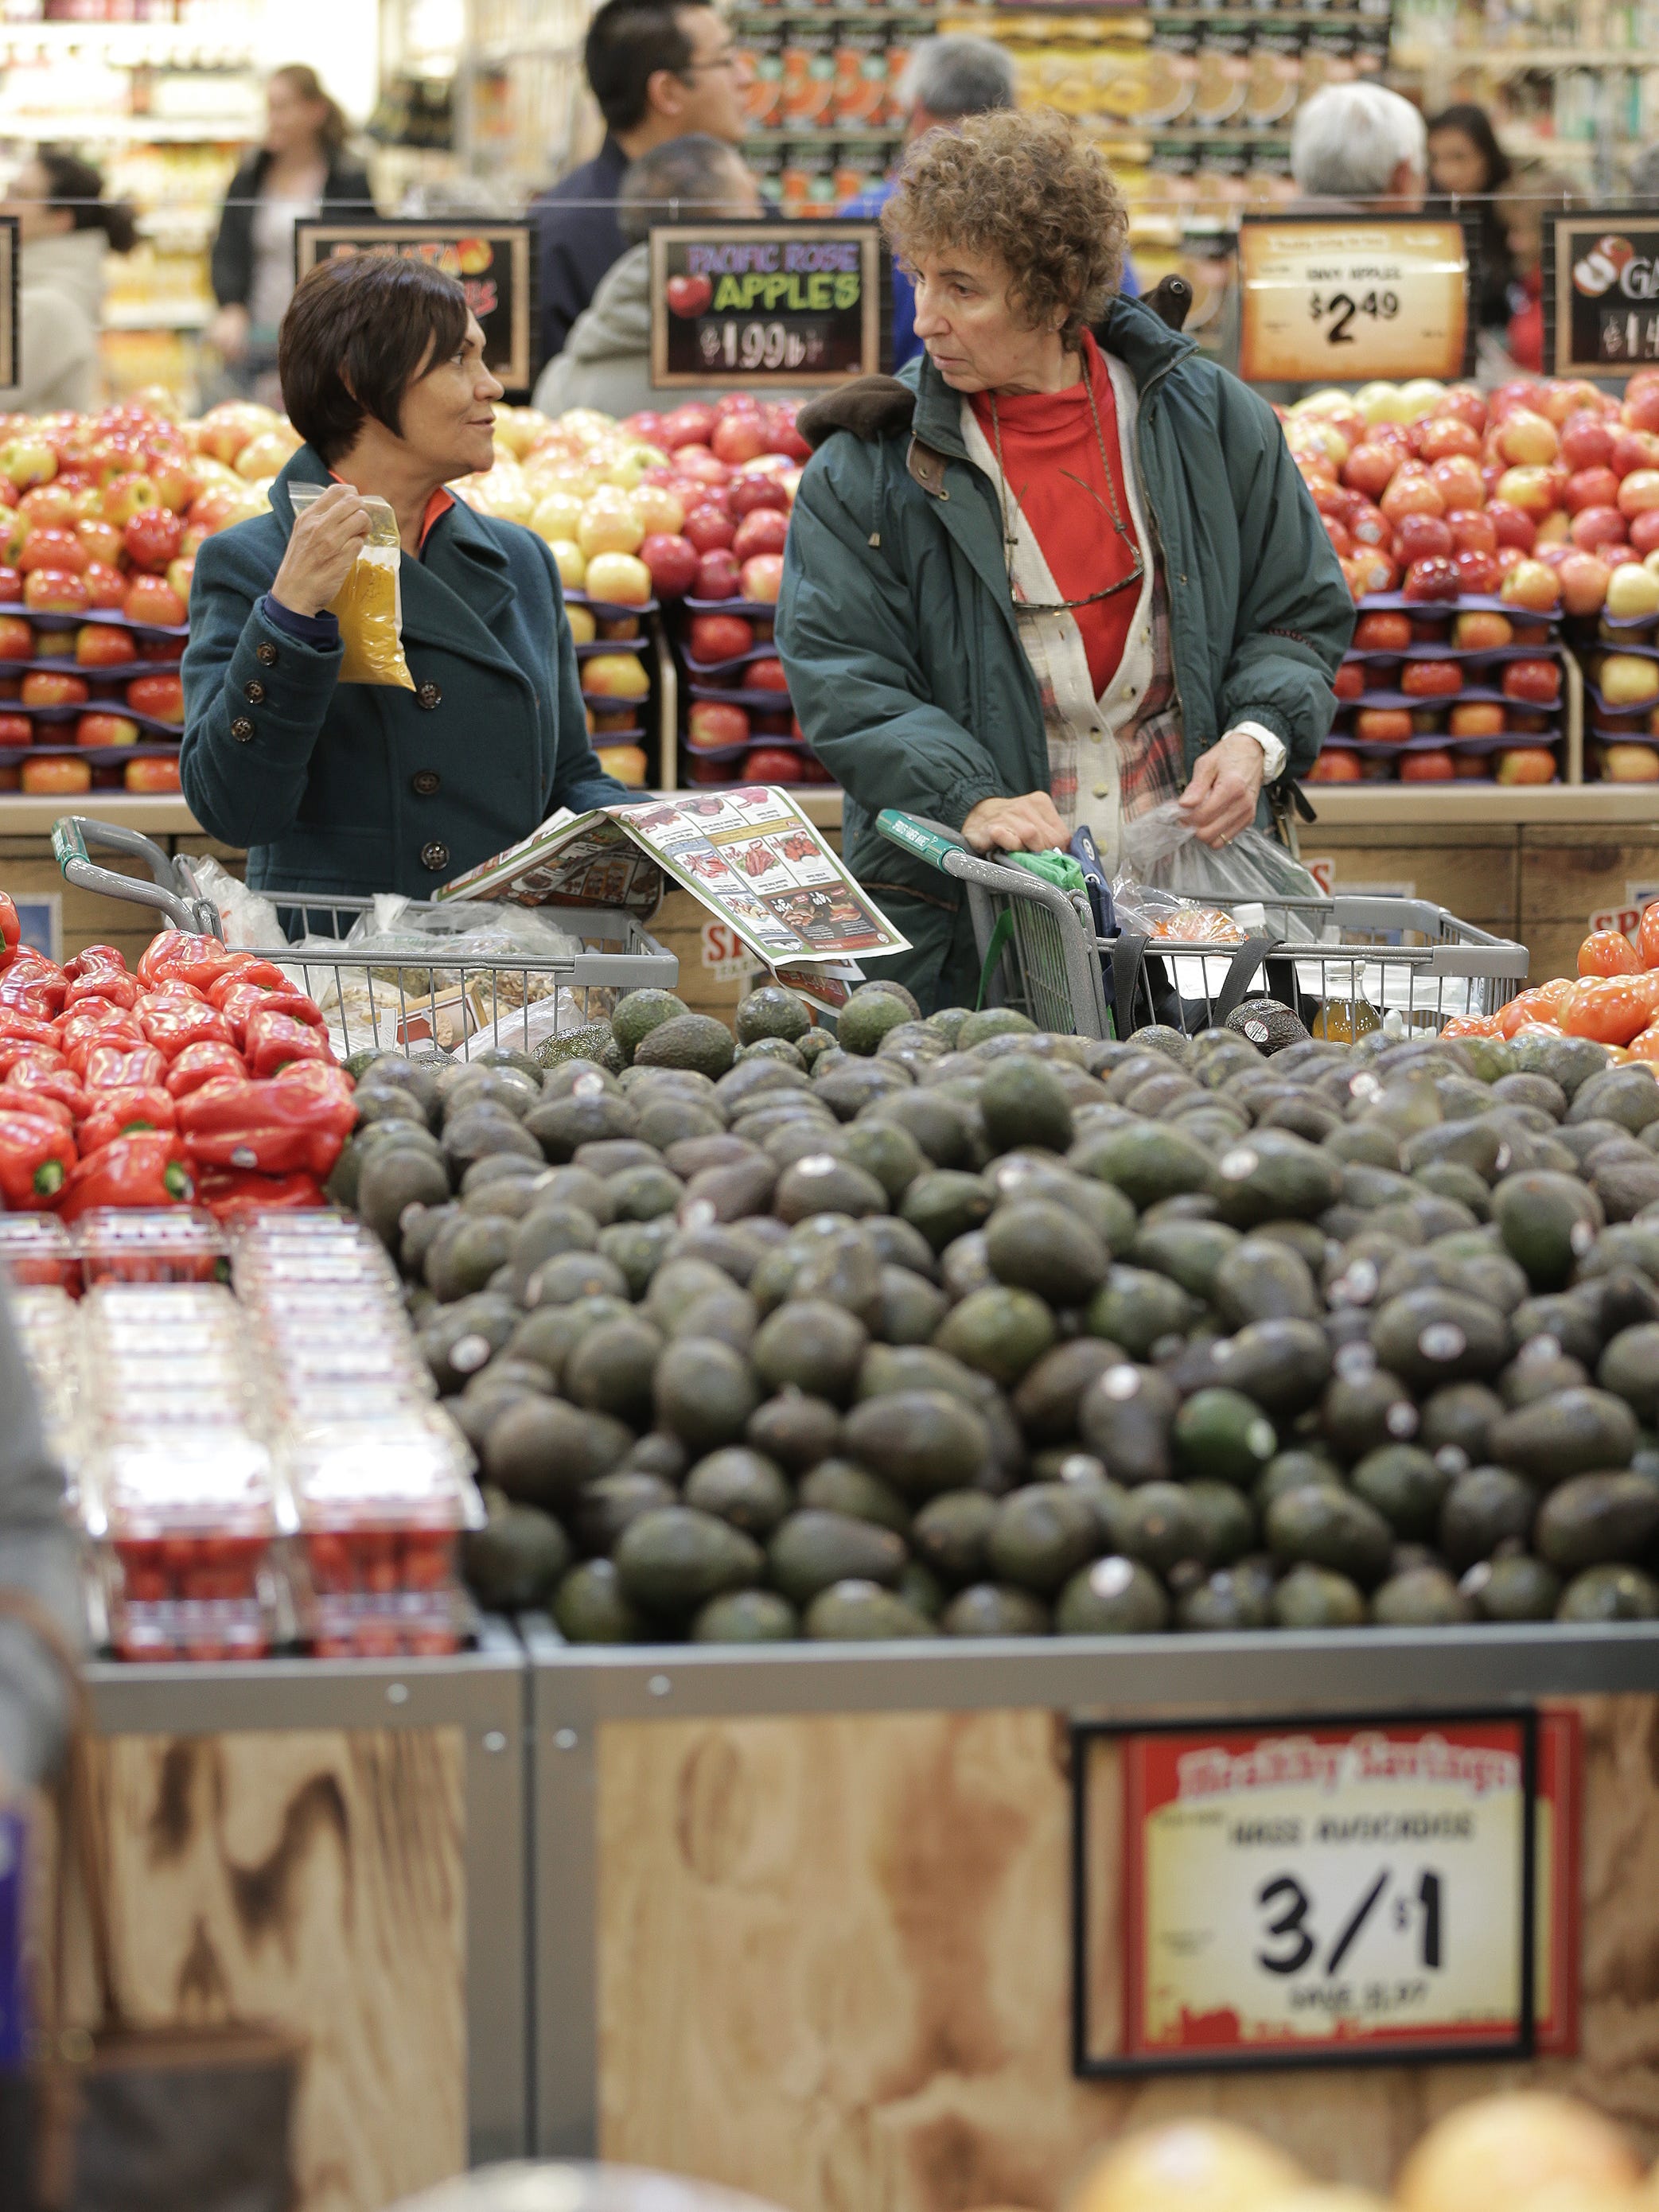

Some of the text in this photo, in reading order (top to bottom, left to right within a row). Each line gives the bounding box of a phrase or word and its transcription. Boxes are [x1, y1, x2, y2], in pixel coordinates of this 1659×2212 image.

[688, 243, 859, 273] PACIFIC ROSE
[714, 273, 860, 311] APPLES
